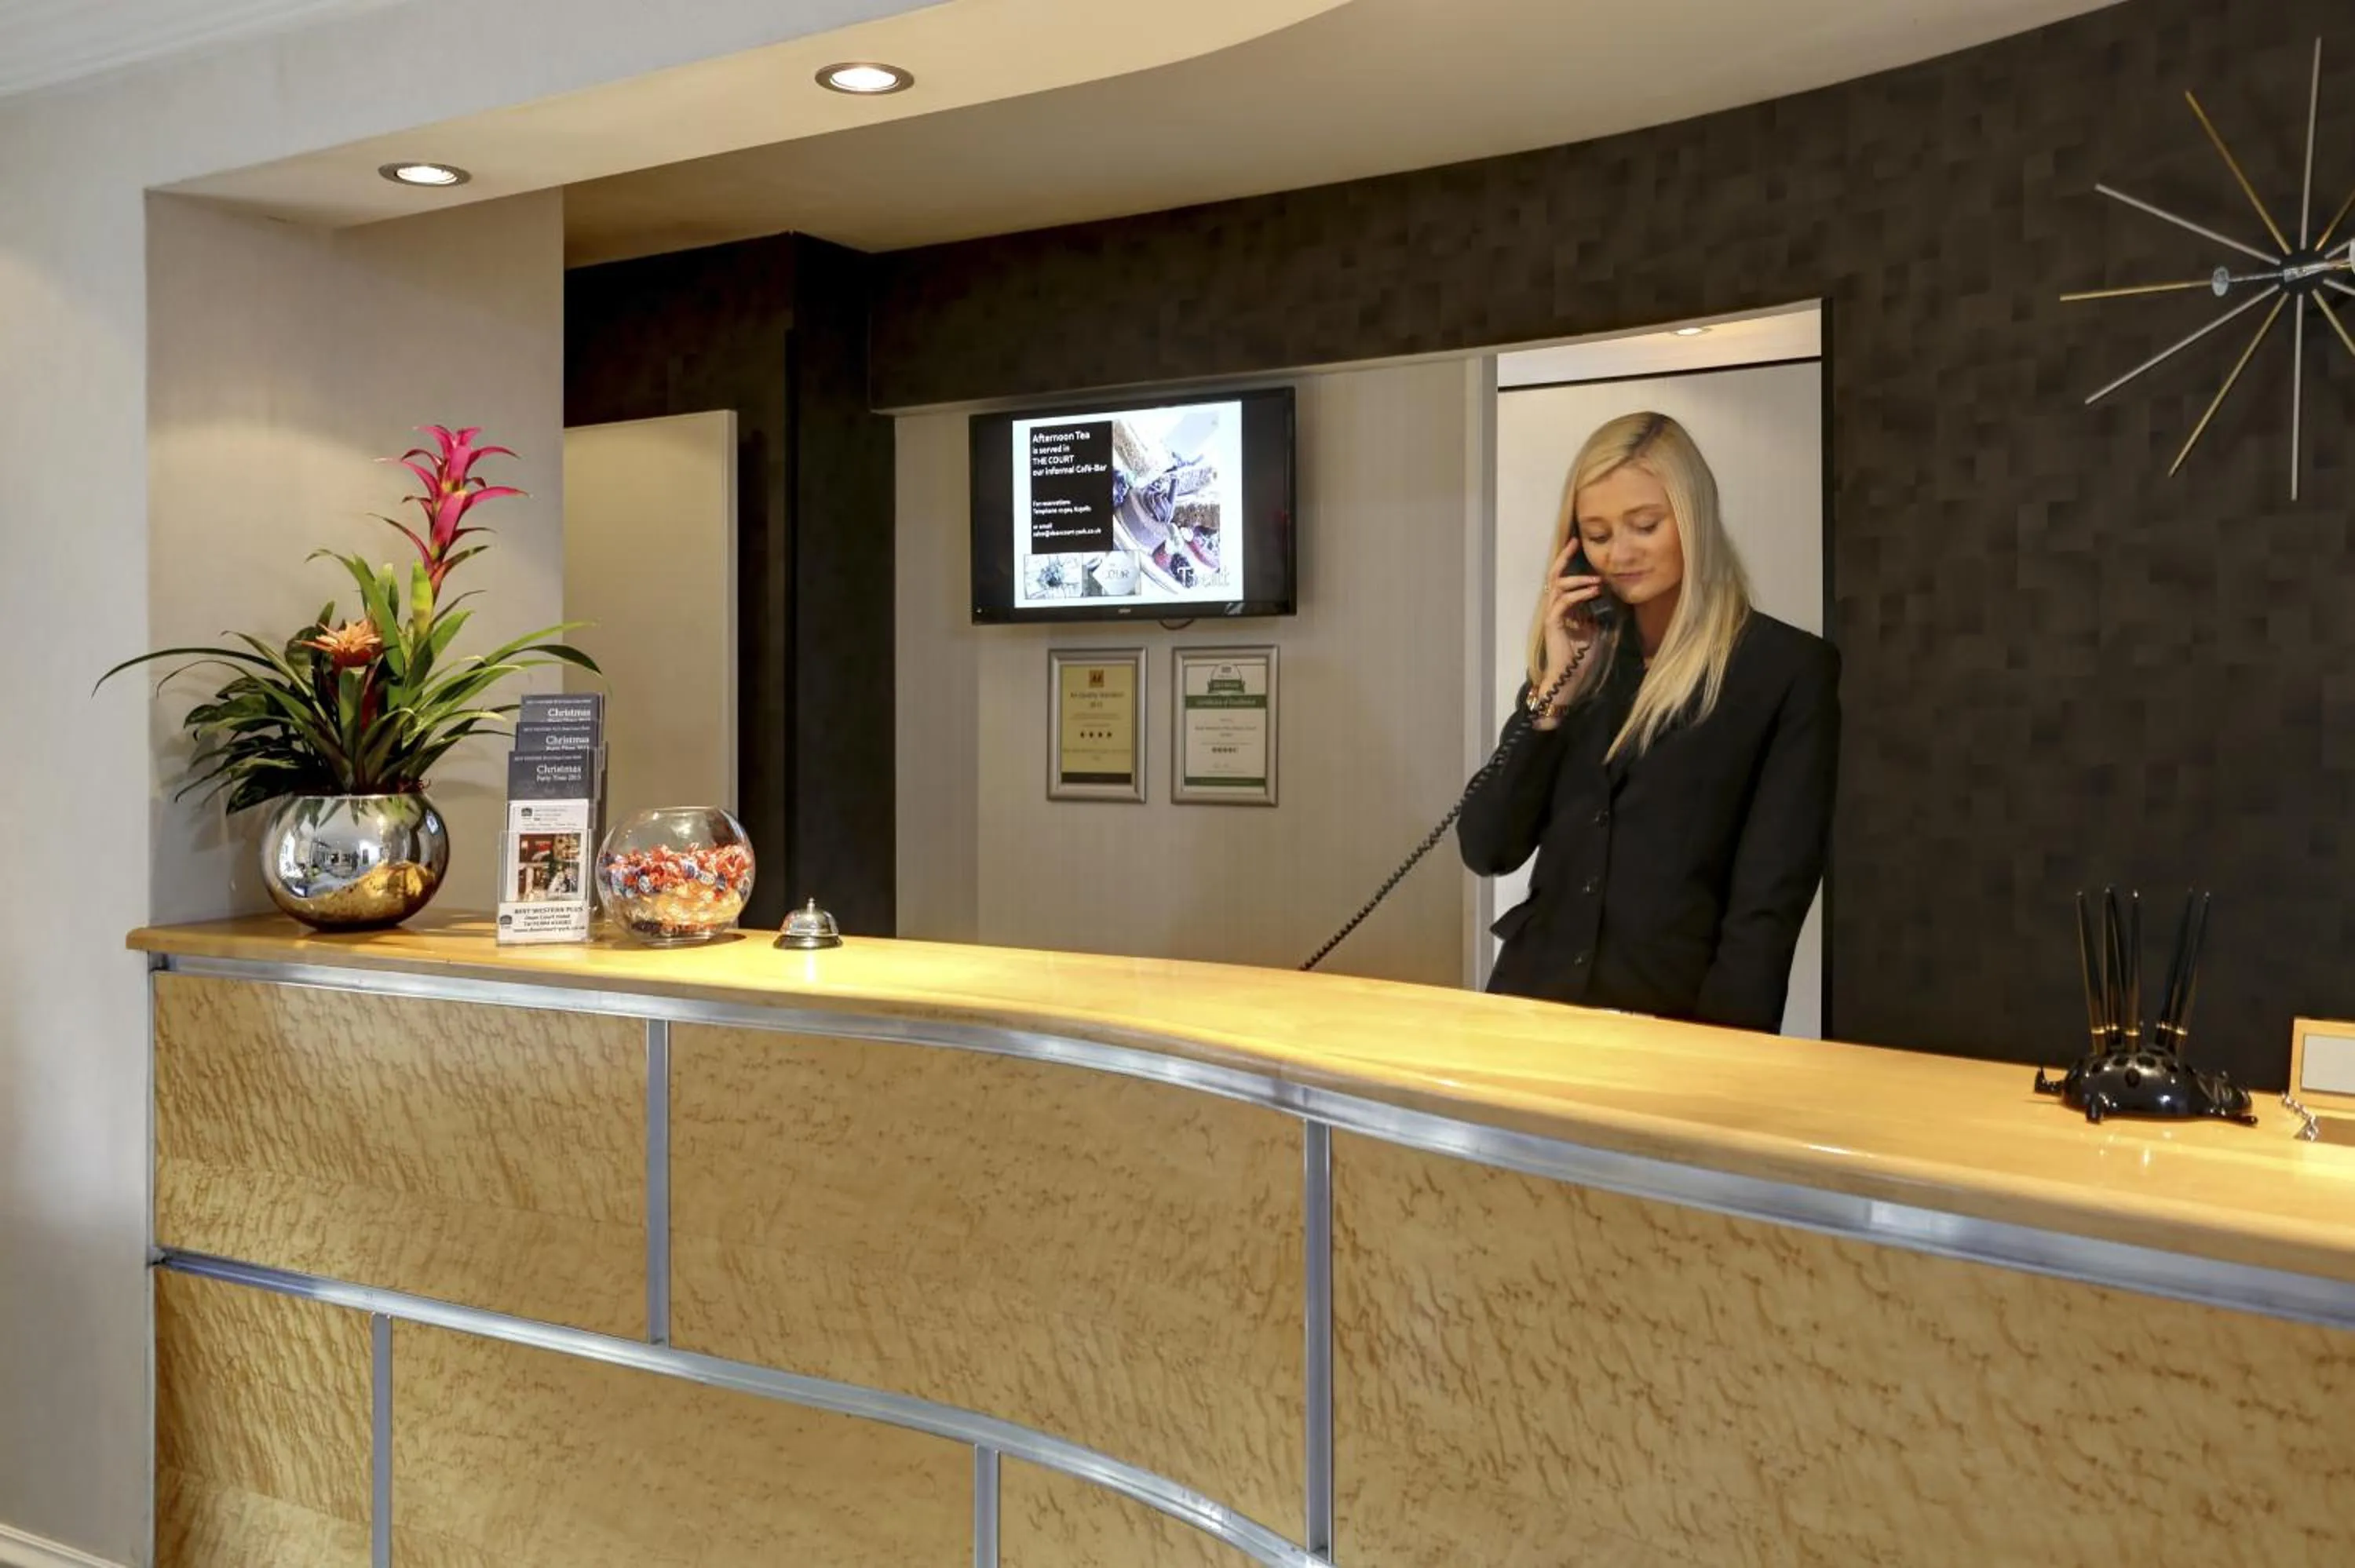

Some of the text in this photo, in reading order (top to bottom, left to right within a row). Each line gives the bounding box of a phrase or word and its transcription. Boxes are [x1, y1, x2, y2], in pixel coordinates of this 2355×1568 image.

[1032, 430, 1090, 443] Afternoon Tea
[1032, 443, 1070, 455] is served in
[1032, 454, 1074, 465] THE COURT
[1044, 465, 1075, 476] informal
[547, 708, 591, 717] Christmas
[546, 735, 590, 746] Christmas
[536, 764, 582, 775] Christmas
